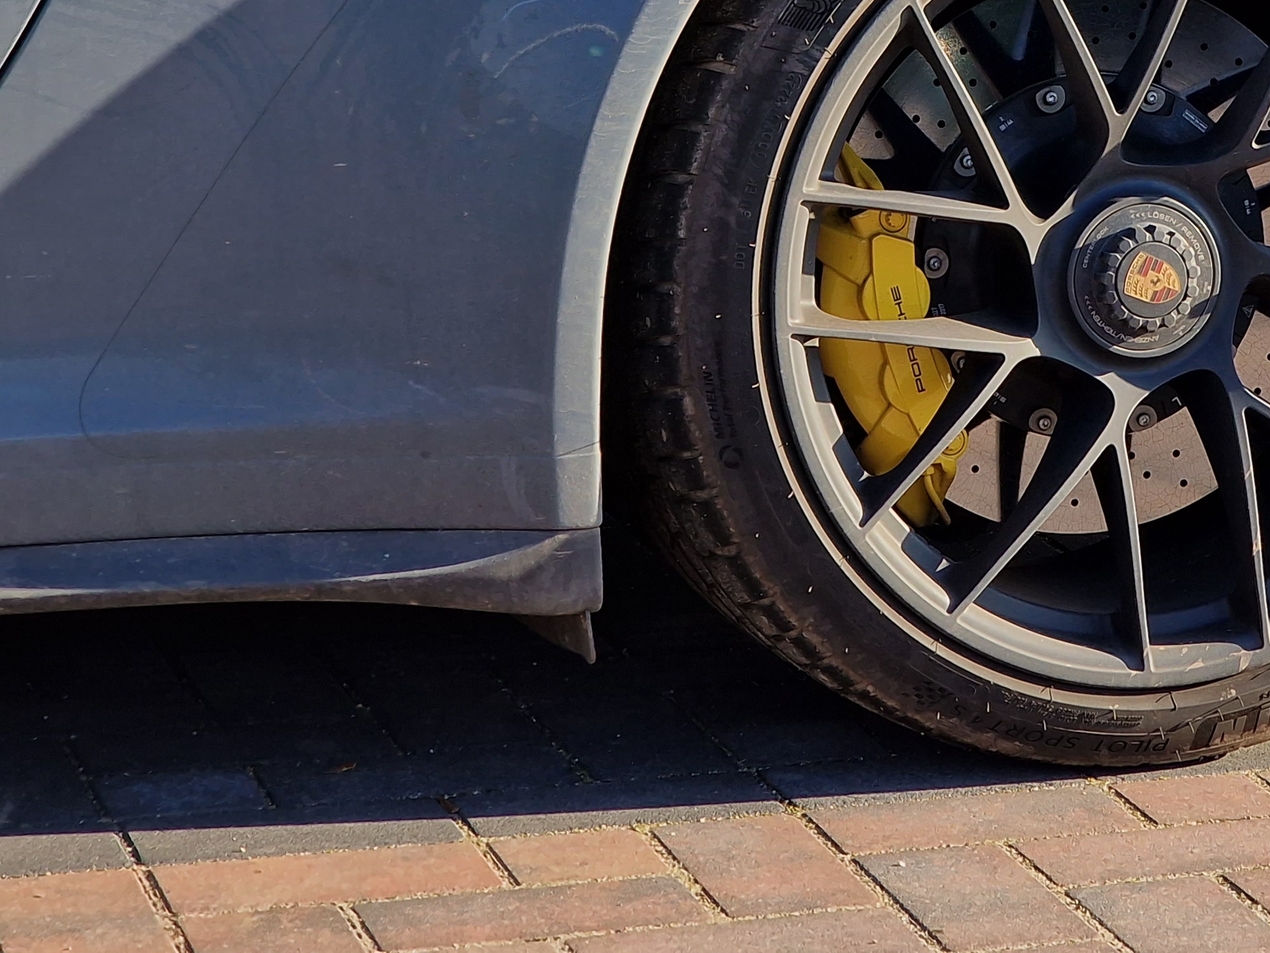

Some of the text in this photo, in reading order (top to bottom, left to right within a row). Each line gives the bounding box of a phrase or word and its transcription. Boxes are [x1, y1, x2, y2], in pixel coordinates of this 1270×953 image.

[890, 285, 926, 393] PORHE
[703, 368, 726, 439] MICHELIN
[986, 718, 1080, 750] SPORT
[1092, 735, 1170, 753] PILOT
